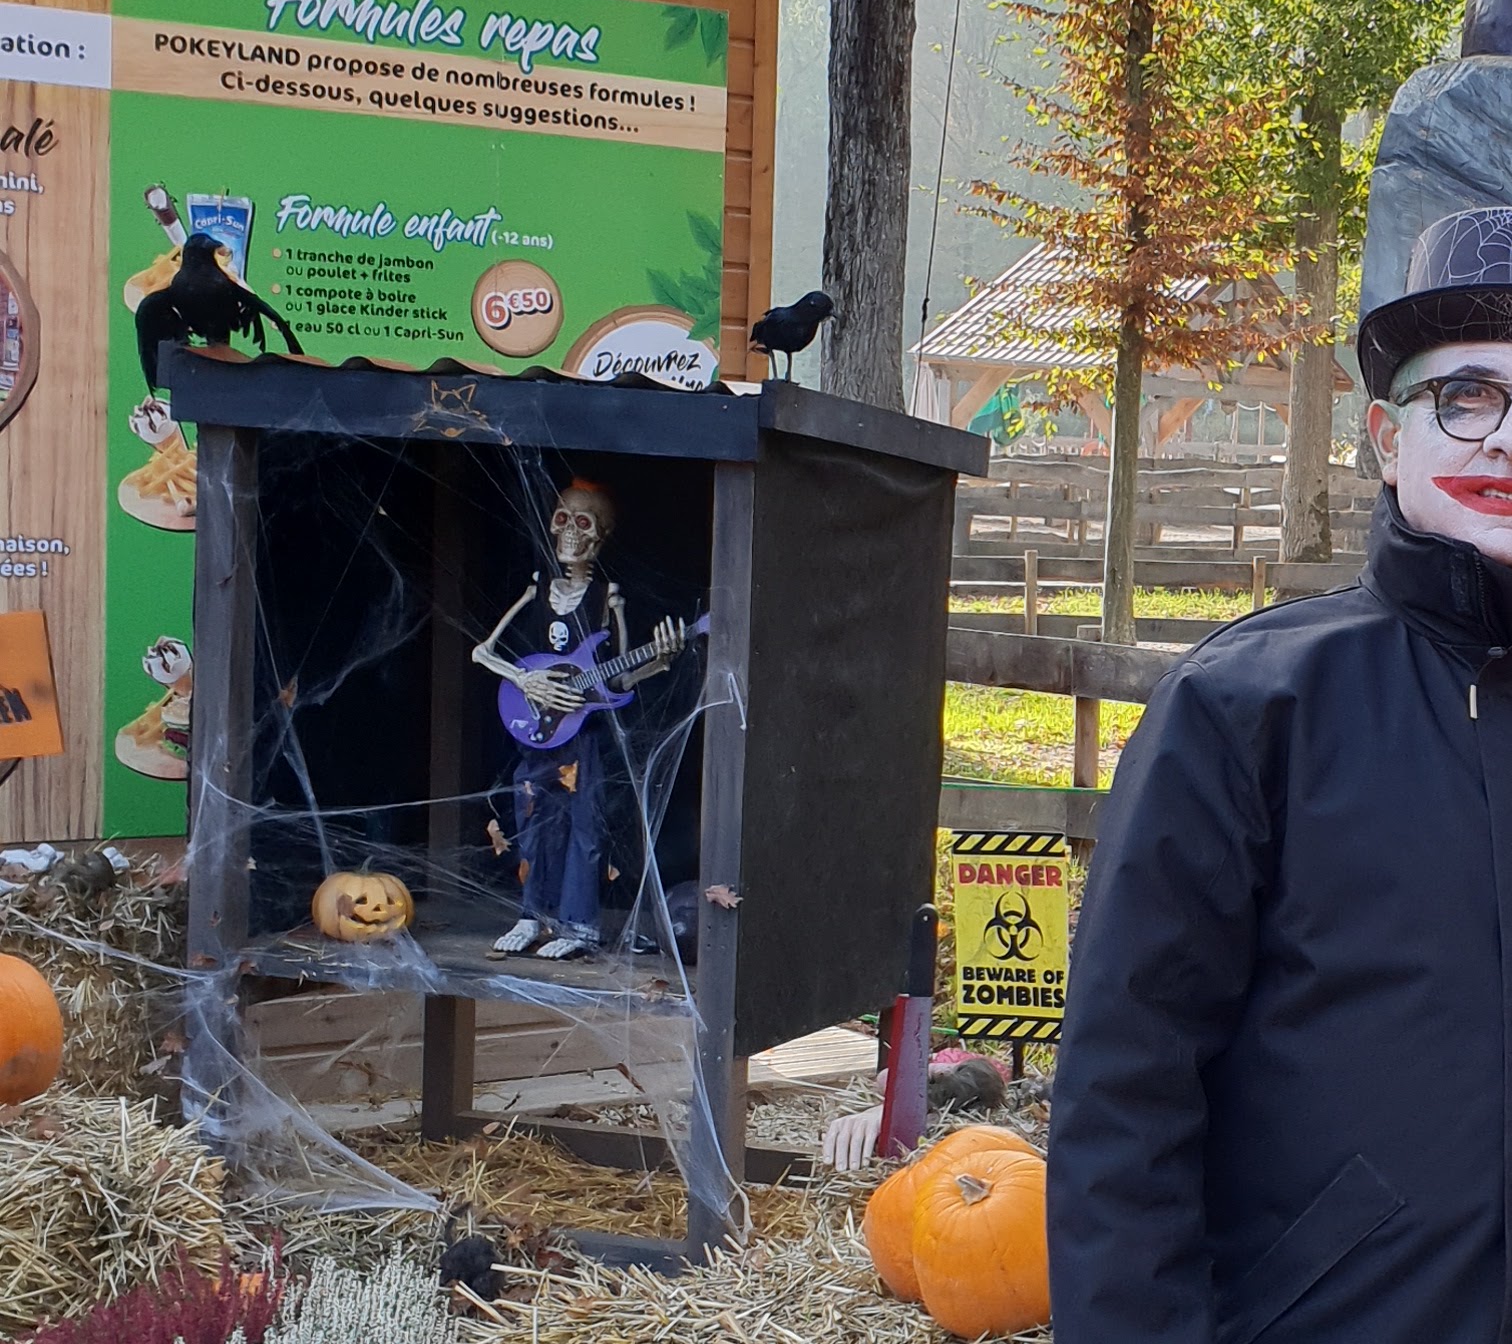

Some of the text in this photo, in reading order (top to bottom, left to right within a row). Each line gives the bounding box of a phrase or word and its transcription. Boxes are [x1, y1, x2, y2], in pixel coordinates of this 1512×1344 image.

[480, 11, 600, 73] repas
[154, 33, 300, 66] POKEYLAND
[307, 54, 405, 78] propose
[411, 62, 439, 82] de
[446, 70, 583, 99] nombreuses
[590, 83, 685, 110] formules
[220, 70, 639, 133] Ci-dessous, quelques suggestions...
[195, 215, 244, 232] Capri-Sun
[276, 194, 396, 238] Formule
[403, 206, 502, 252] enfant
[522, 234, 553, 249] ans)
[297, 249, 352, 263] tranche
[357, 253, 375, 265] de
[378, 256, 433, 270] jambon
[286, 266, 302, 275] ou
[307, 266, 356, 280] poulet
[372, 270, 410, 282] frites
[296, 287, 362, 301] compote
[365, 288, 374, 300] à
[378, 290, 416, 303] boire
[286, 302, 302, 311] ou
[316, 301, 356, 315] glace
[360, 304, 409, 318] Kinder
[412, 307, 447, 320] stick
[295, 323, 321, 333] eau
[326, 322, 343, 334] 50
[347, 323, 361, 335] cl
[364, 326, 380, 336] ou
[394, 326, 464, 341] Capri-Sun
[593, 350, 701, 377] Découvrez
[958, 863, 1063, 887] DANGER
[963, 966, 1064, 985] BEWARE OF
[962, 984, 1064, 1008] ZOMBIES
